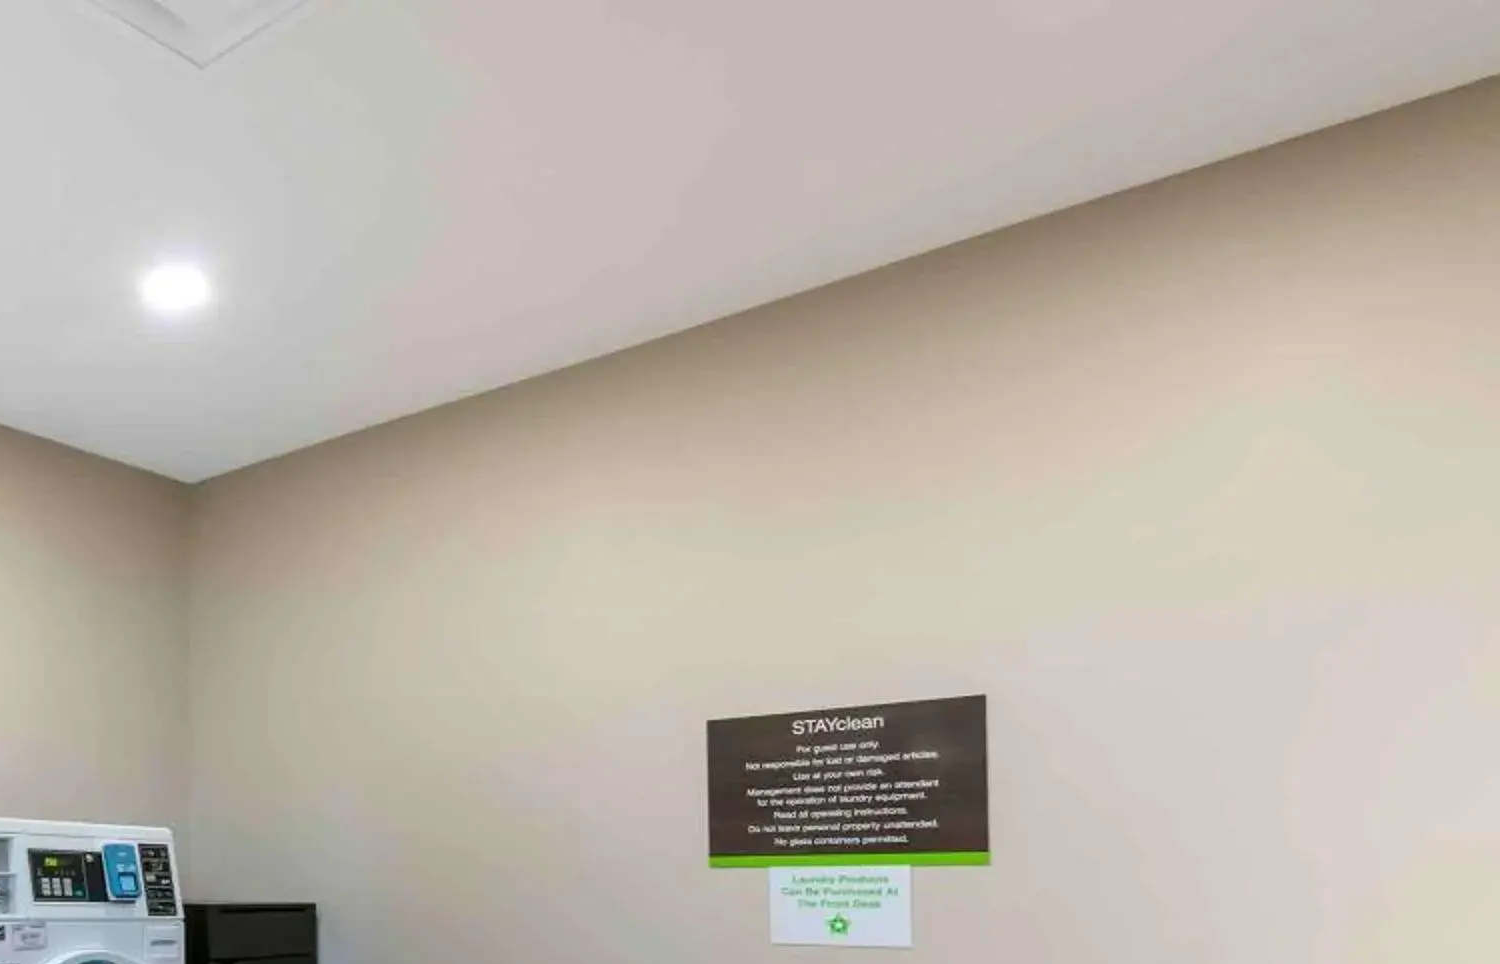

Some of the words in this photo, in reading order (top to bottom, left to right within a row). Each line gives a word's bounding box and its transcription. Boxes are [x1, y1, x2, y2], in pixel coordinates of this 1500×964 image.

[792, 716, 884, 735] STAYclean
[796, 745, 811, 753] For
[813, 744, 837, 755] guest
[840, 743, 856, 751] use
[745, 762, 760, 771] Not
[762, 759, 810, 771] responsible
[812, 758, 824, 767] for
[826, 757, 842, 765] lost
[844, 756, 854, 764] or
[856, 753, 900, 764] damaged
[792, 772, 810, 781] Use
[812, 772, 821, 780] at
[823, 771, 842, 781] your
[844, 770, 864, 778] own
[747, 787, 801, 798] Management
[804, 785, 825, 794] does
[828, 784, 841, 792] not
[843, 783, 877, 793] provide
[880, 782, 892, 790] an
[894, 779, 939, 789] attendant
[757, 798, 768, 807] for
[770, 798, 784, 806] the
[786, 796, 826, 807] operation
[828, 795, 837, 804] of
[840, 794, 873, 804] laundry
[874, 791, 928, 802] equipment.
[773, 811, 796, 819] Read
[798, 810, 809, 819] all
[810, 808, 852, 820] operating
[748, 825, 760, 834] Do
[762, 824, 776, 833] not
[778, 824, 800, 833] leave
[802, 822, 840, 833] personal
[842, 822, 880, 832] property
[773, 838, 788, 847] No
[790, 837, 812, 847] glass
[813, 836, 861, 846] containers
